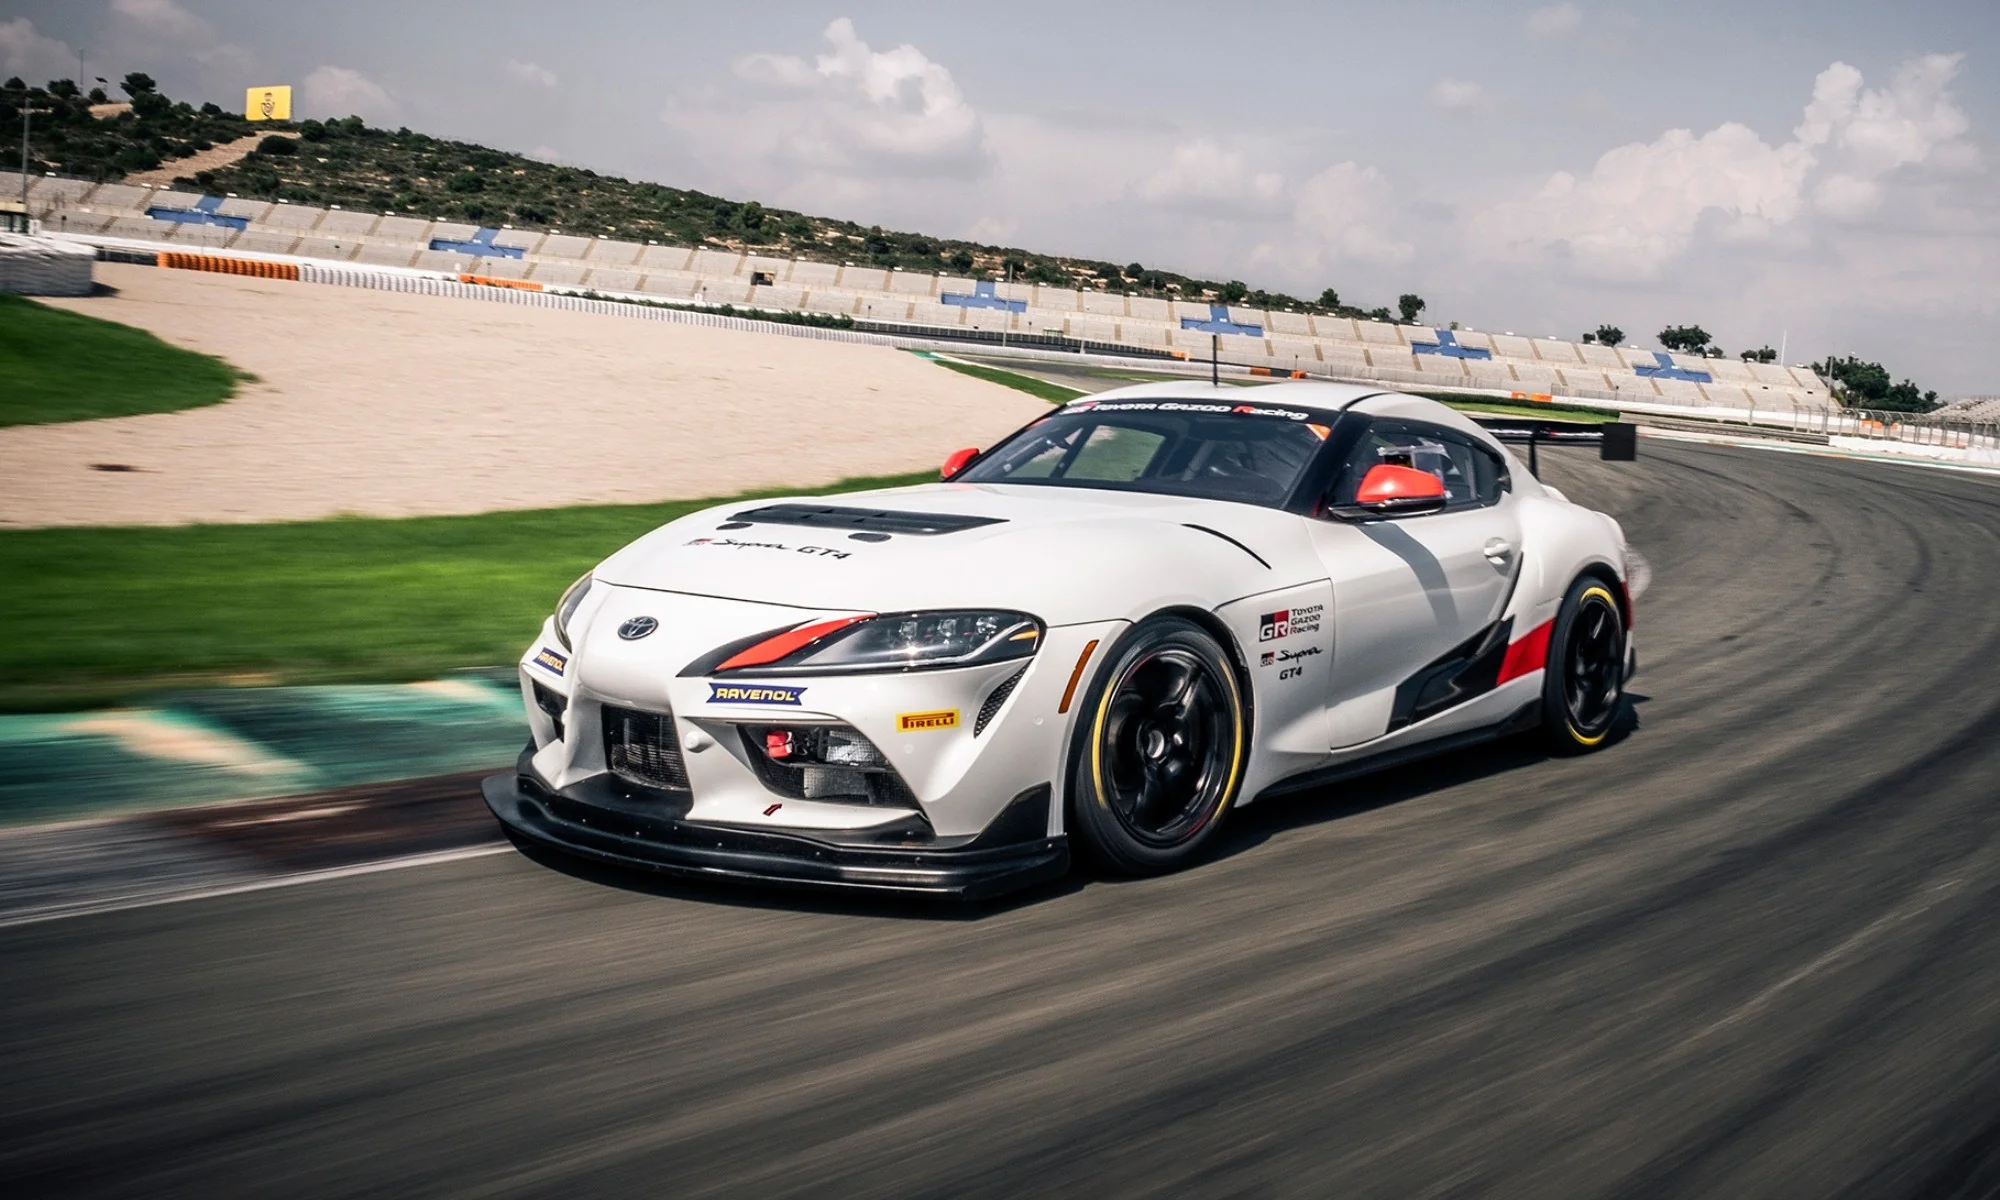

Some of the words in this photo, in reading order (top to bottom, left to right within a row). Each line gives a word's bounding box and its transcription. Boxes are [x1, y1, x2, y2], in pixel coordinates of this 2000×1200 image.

[1092, 402, 1157, 411] TOYOTA
[1157, 403, 1232, 412] GAZOO
[1232, 405, 1309, 420] Racing
[711, 538, 791, 550] Supra
[797, 546, 852, 559] GT4
[1291, 604, 1323, 616] TOYOTA
[1291, 614, 1321, 626] GAZOO
[1260, 620, 1288, 641] GR
[1290, 623, 1320, 634] Racing
[1276, 646, 1323, 663] Supra
[1279, 666, 1303, 680] GT4
[716, 688, 795, 702] RAVENOL
[902, 712, 954, 729] PIRELLI
